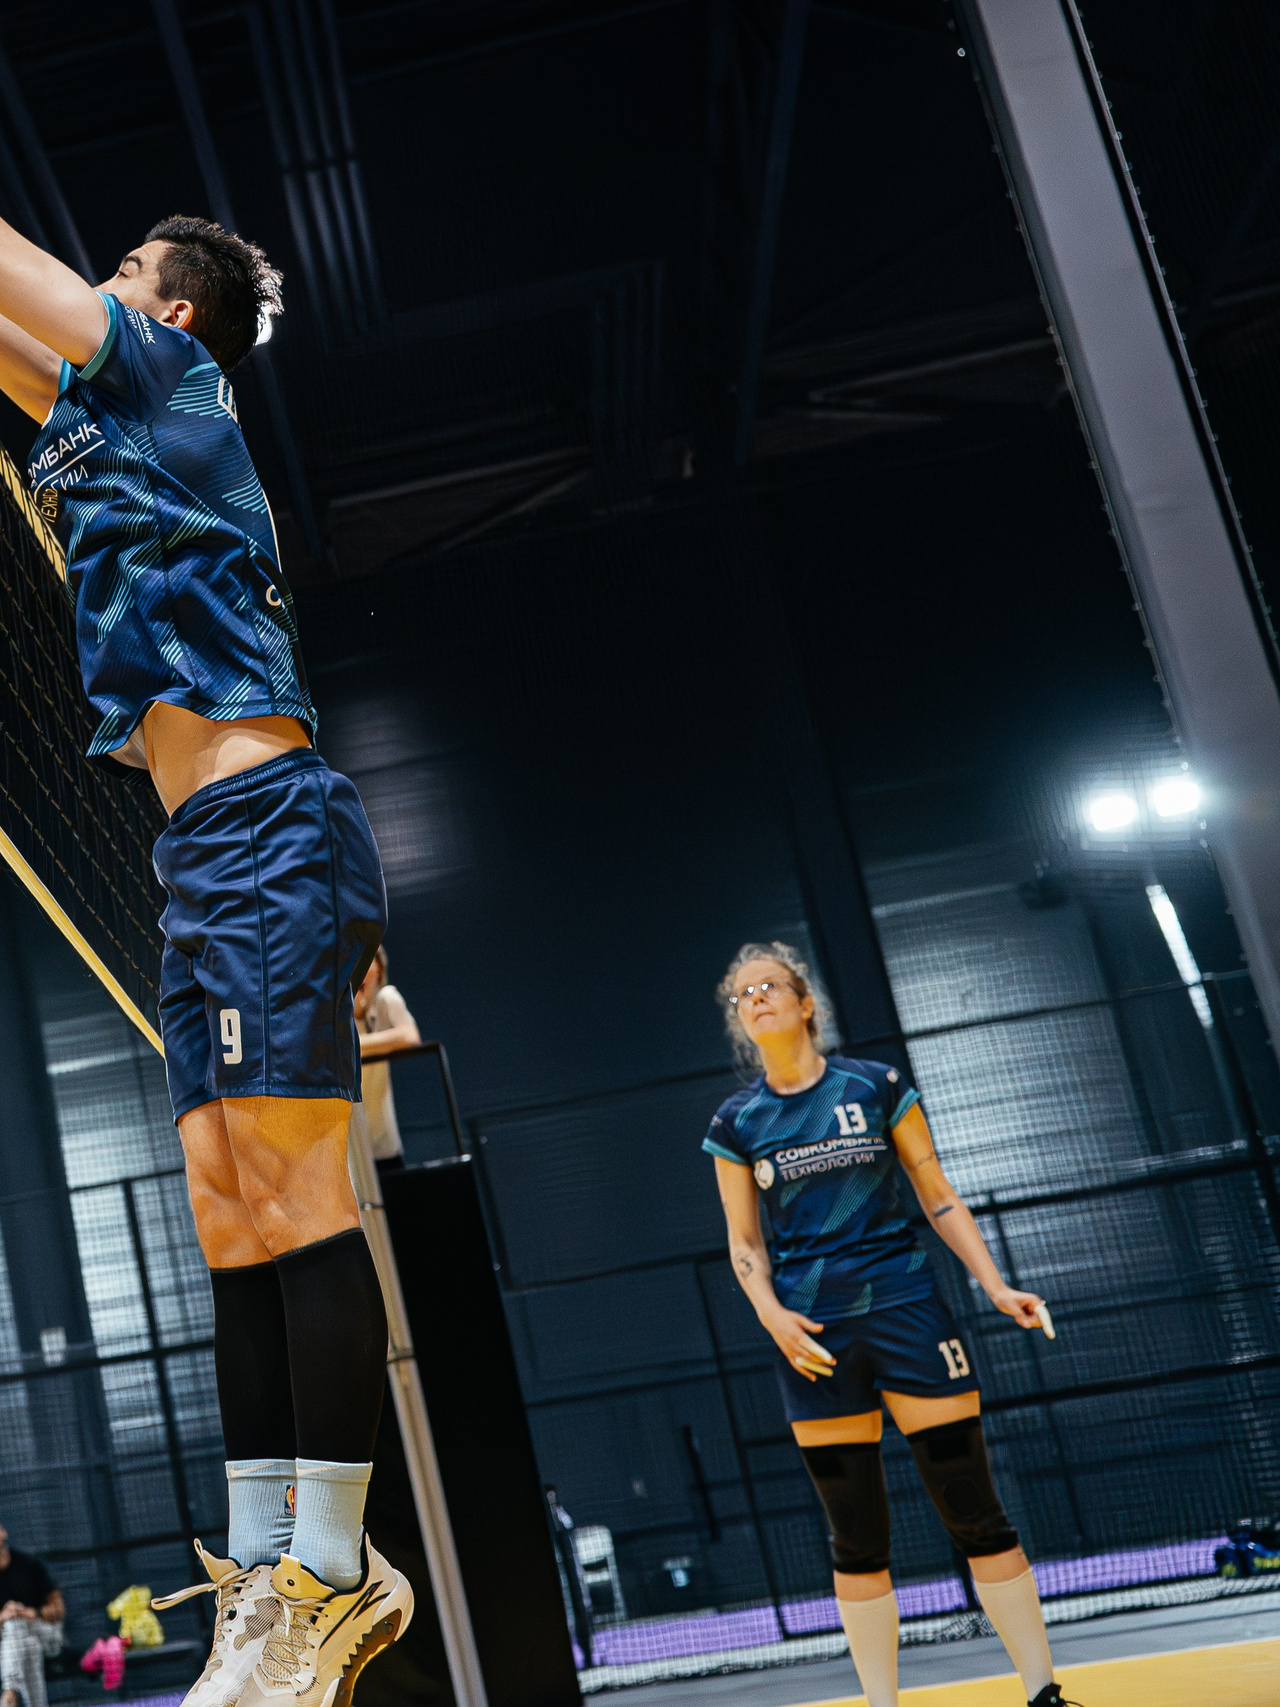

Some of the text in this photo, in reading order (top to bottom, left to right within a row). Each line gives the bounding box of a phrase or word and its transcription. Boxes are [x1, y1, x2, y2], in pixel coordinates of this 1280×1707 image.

[220, 1008, 243, 1064] 9
[833, 1102, 868, 1136] 13
[781, 1152, 876, 1182] ТЕХНОЛОГИИ
[937, 1338, 971, 1380] 13
